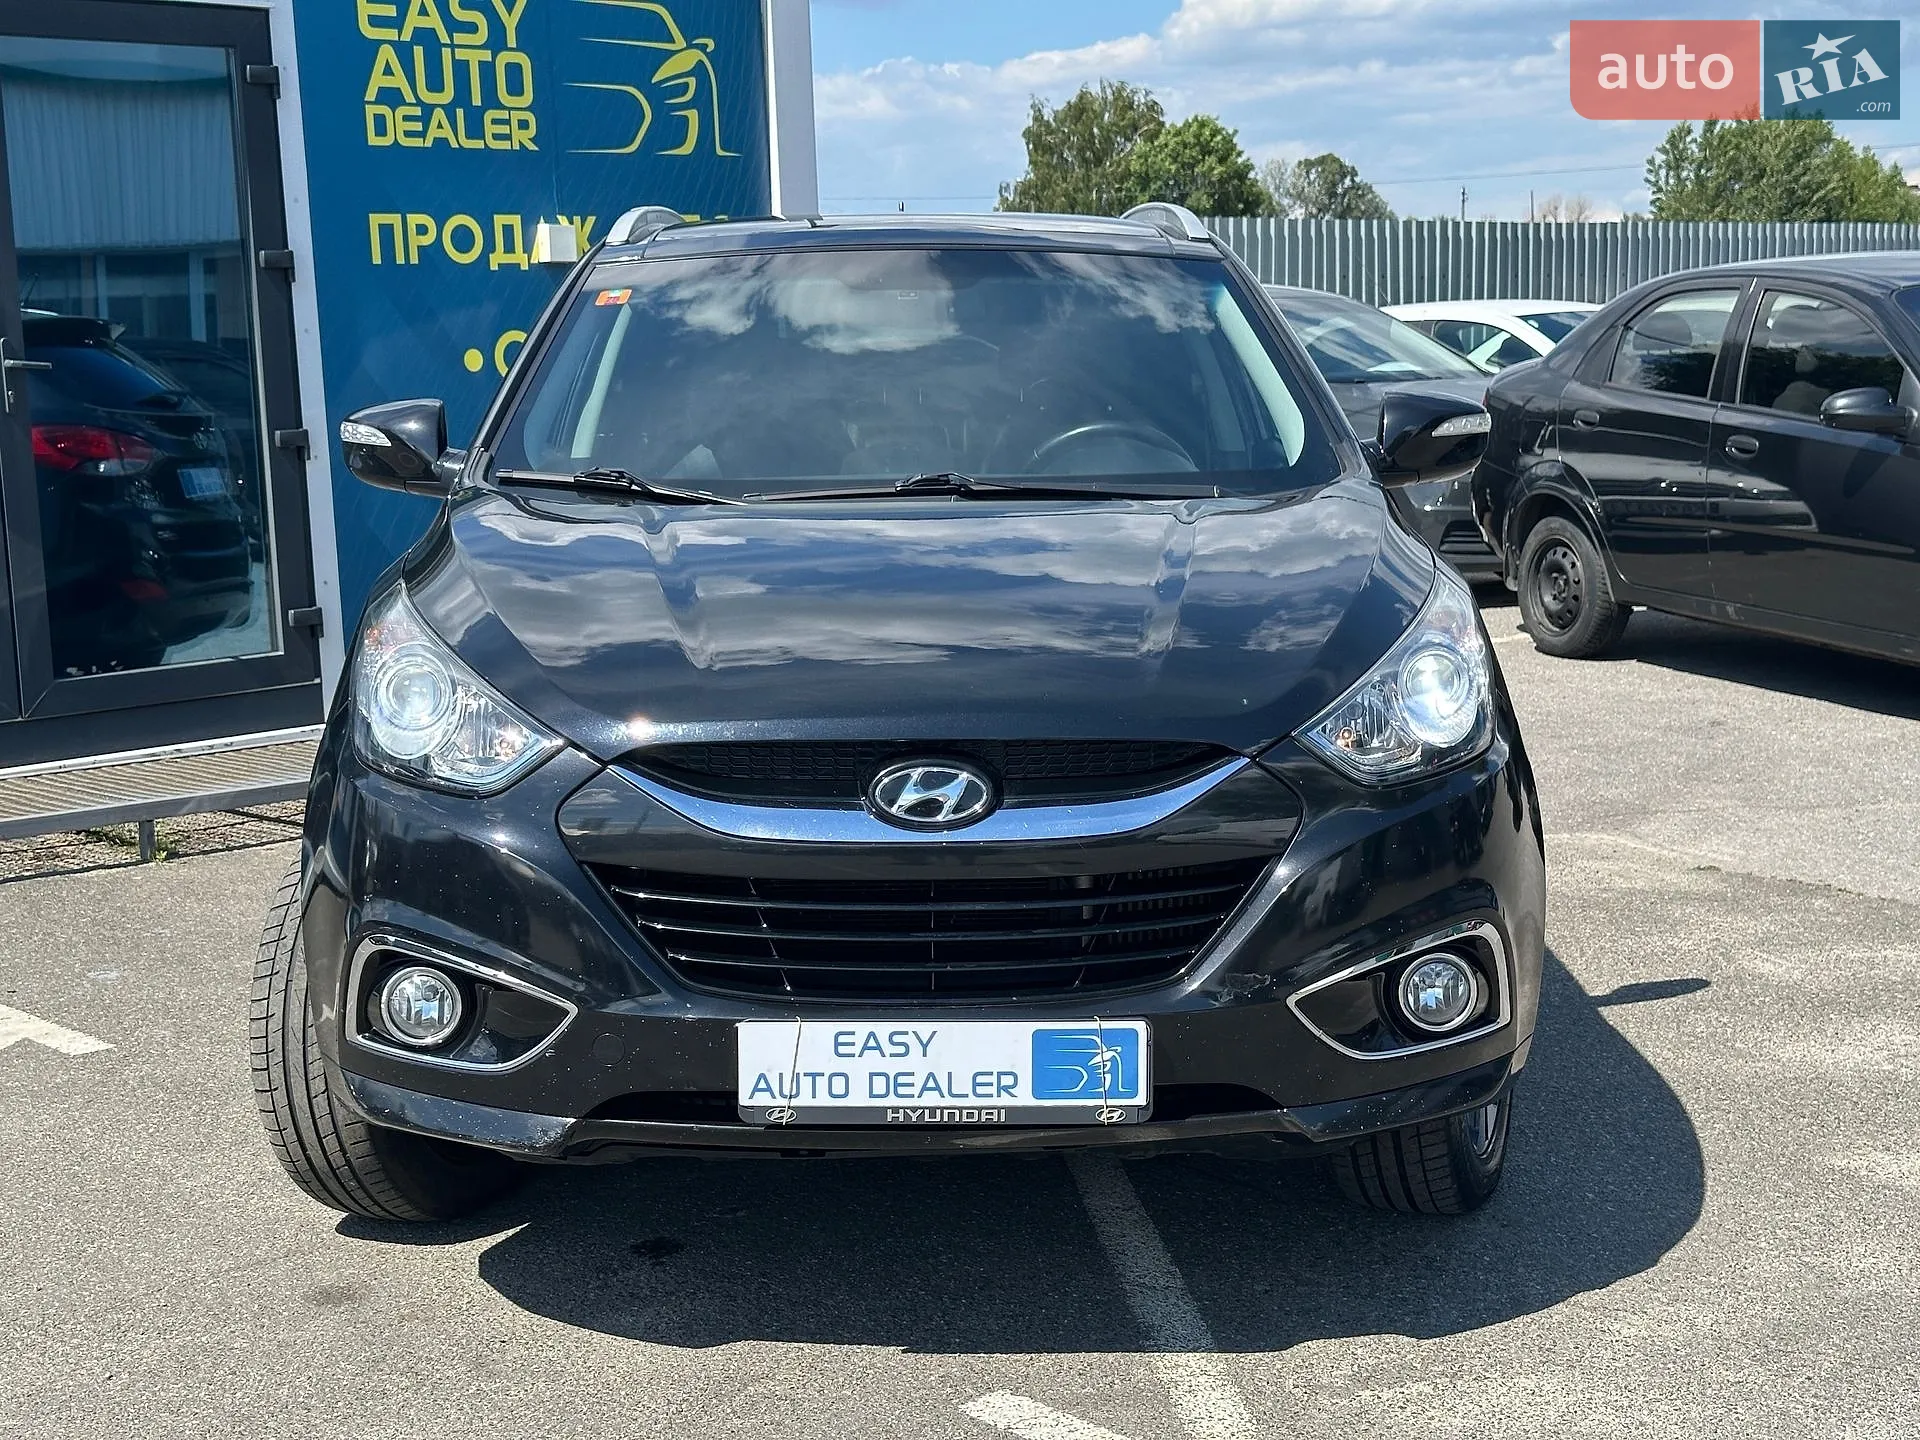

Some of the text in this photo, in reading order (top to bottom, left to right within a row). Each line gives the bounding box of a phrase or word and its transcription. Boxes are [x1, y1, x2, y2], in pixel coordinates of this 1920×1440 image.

[357, 0, 528, 48] EASY
[364, 43, 534, 109] AUTO
[365, 104, 540, 151] DEALER
[833, 1030, 938, 1058] EASY
[748, 1071, 1019, 1099] AUTO DEALER
[886, 1108, 1006, 1122] HYUNDAI
